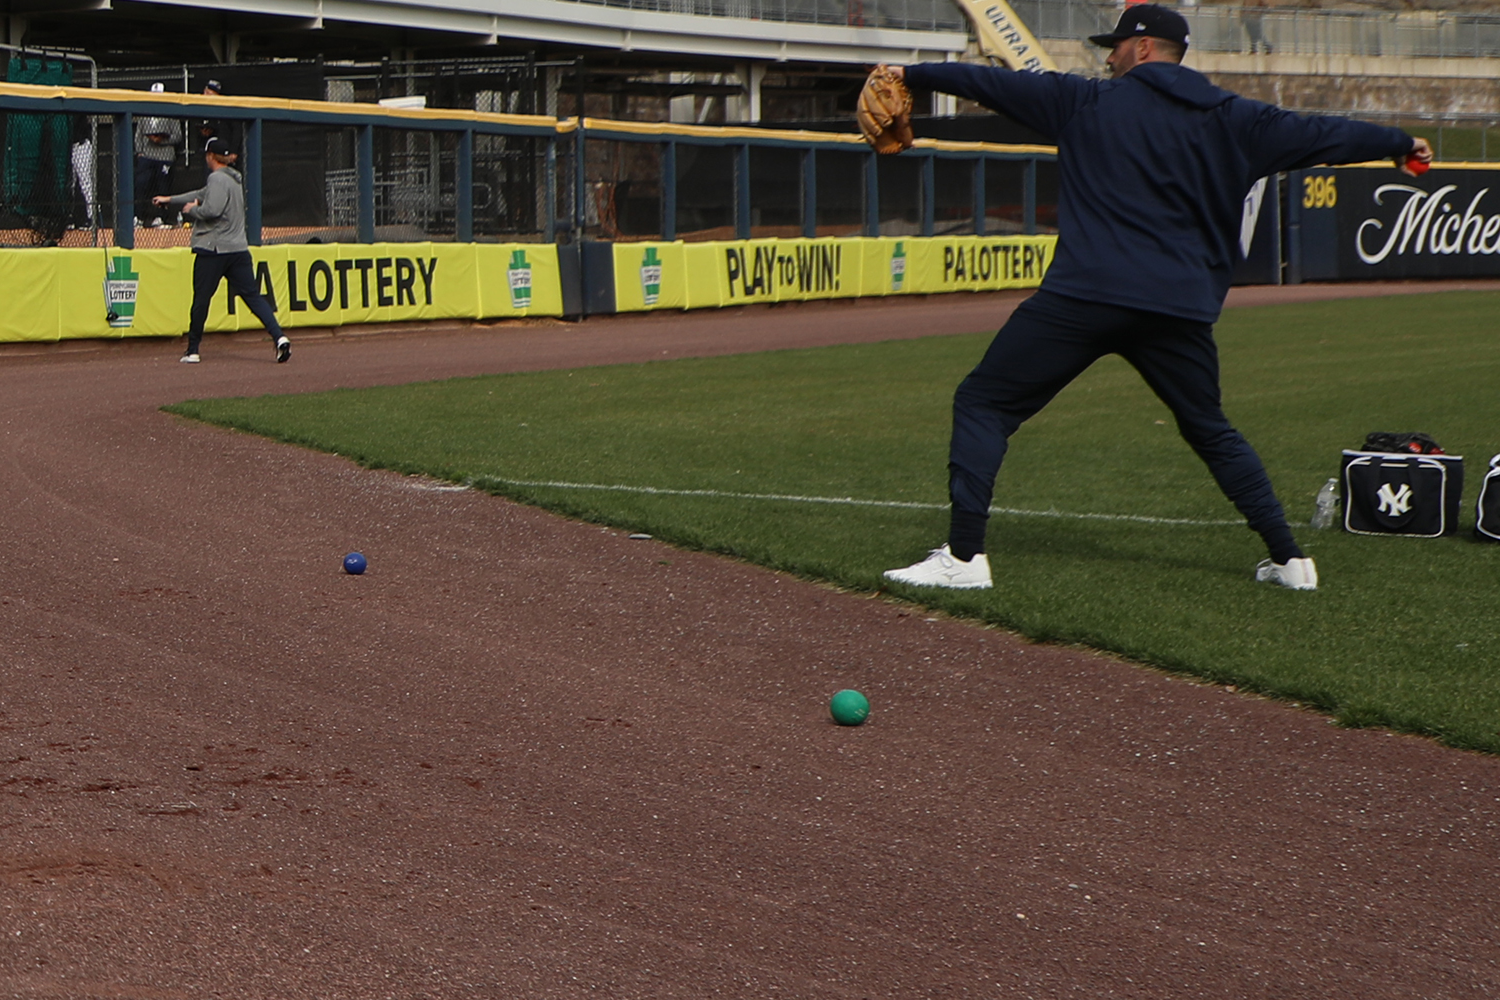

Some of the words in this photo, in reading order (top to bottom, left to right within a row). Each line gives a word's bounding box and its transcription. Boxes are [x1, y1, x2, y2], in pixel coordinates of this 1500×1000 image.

[985, 4, 1029, 58] ULTRA
[1302, 175, 1338, 210] 396
[287, 257, 438, 312] LOTTERY
[726, 246, 777, 297] PLAY
[797, 245, 842, 292] WIN!
[944, 246, 967, 283] PA
[971, 245, 1047, 281] LOTTERY
[110, 290, 136, 300] LOTTERY
[1376, 483, 1414, 517] NY
